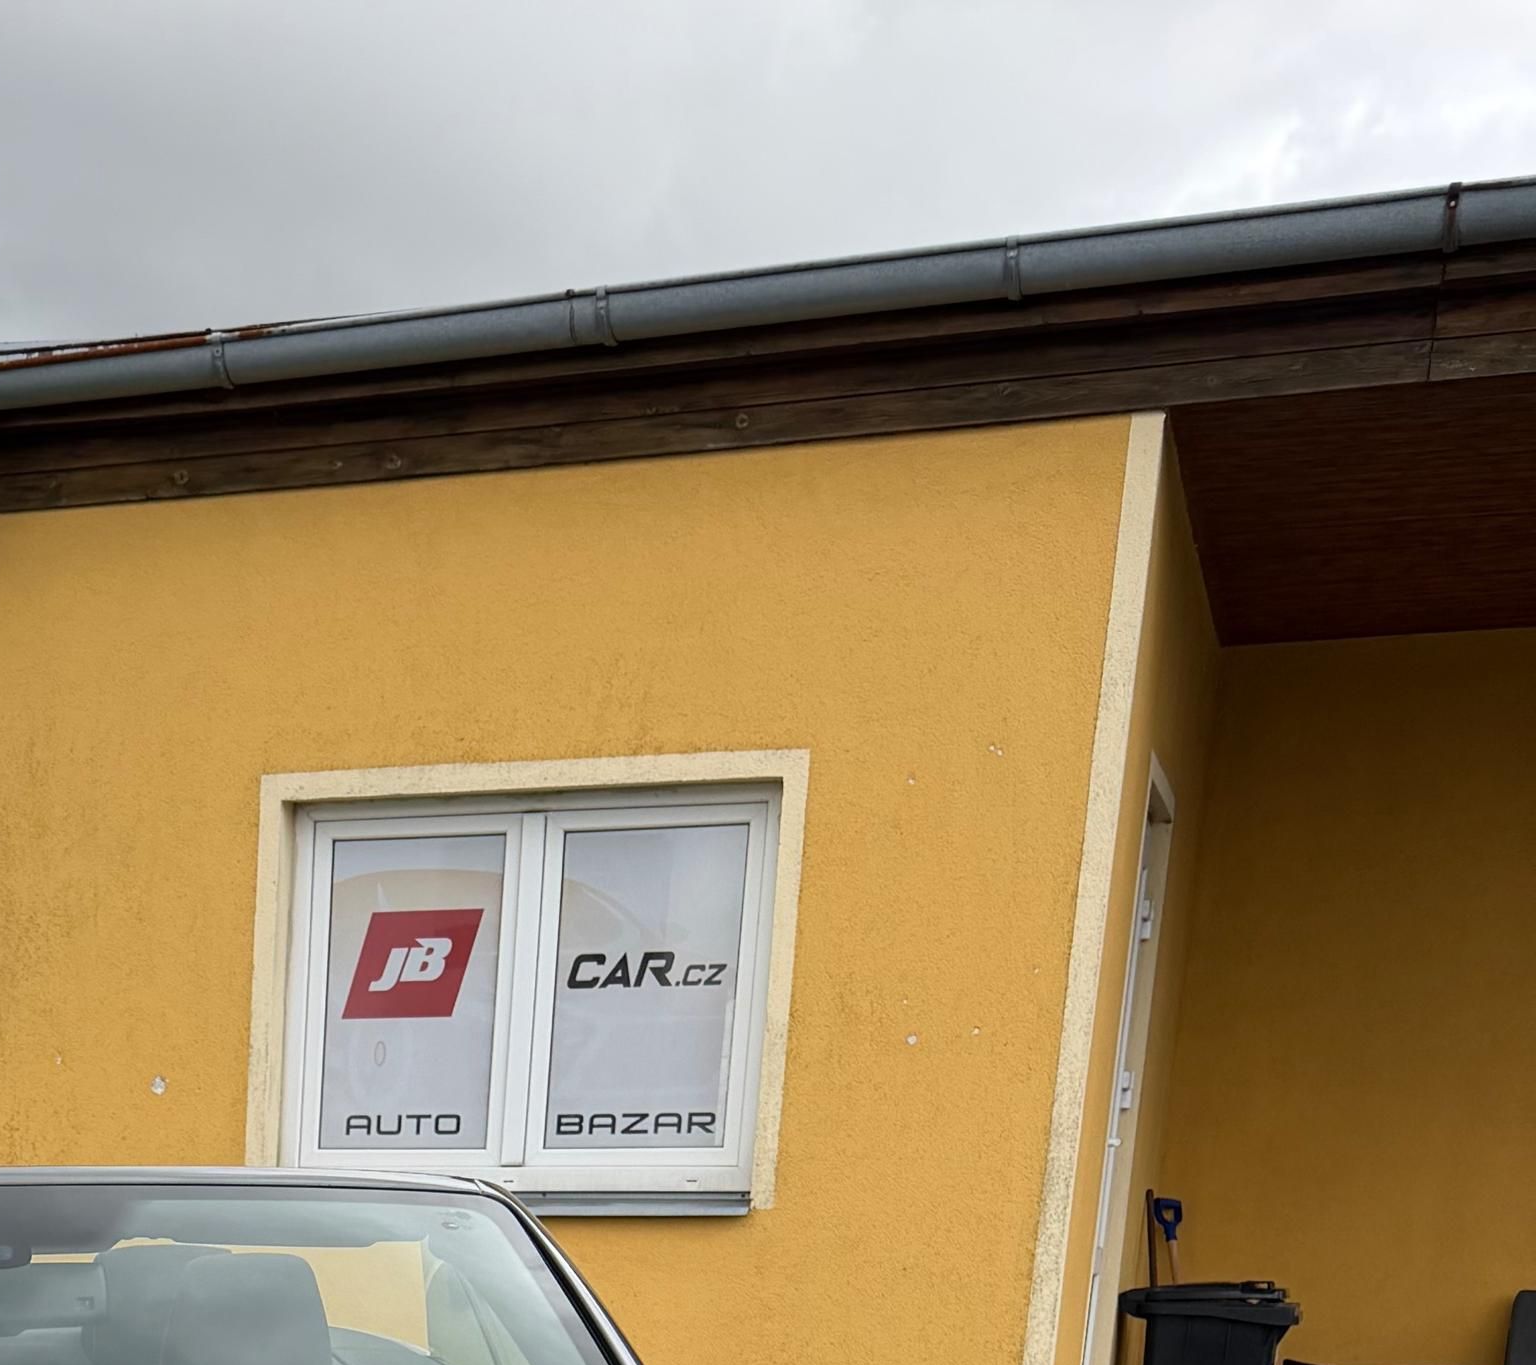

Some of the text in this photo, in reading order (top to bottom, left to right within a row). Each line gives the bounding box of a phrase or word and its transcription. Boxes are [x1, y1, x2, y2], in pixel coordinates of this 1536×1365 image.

[368, 937, 453, 992] JB
[345, 1112, 716, 1136] AUTO BAZAR
